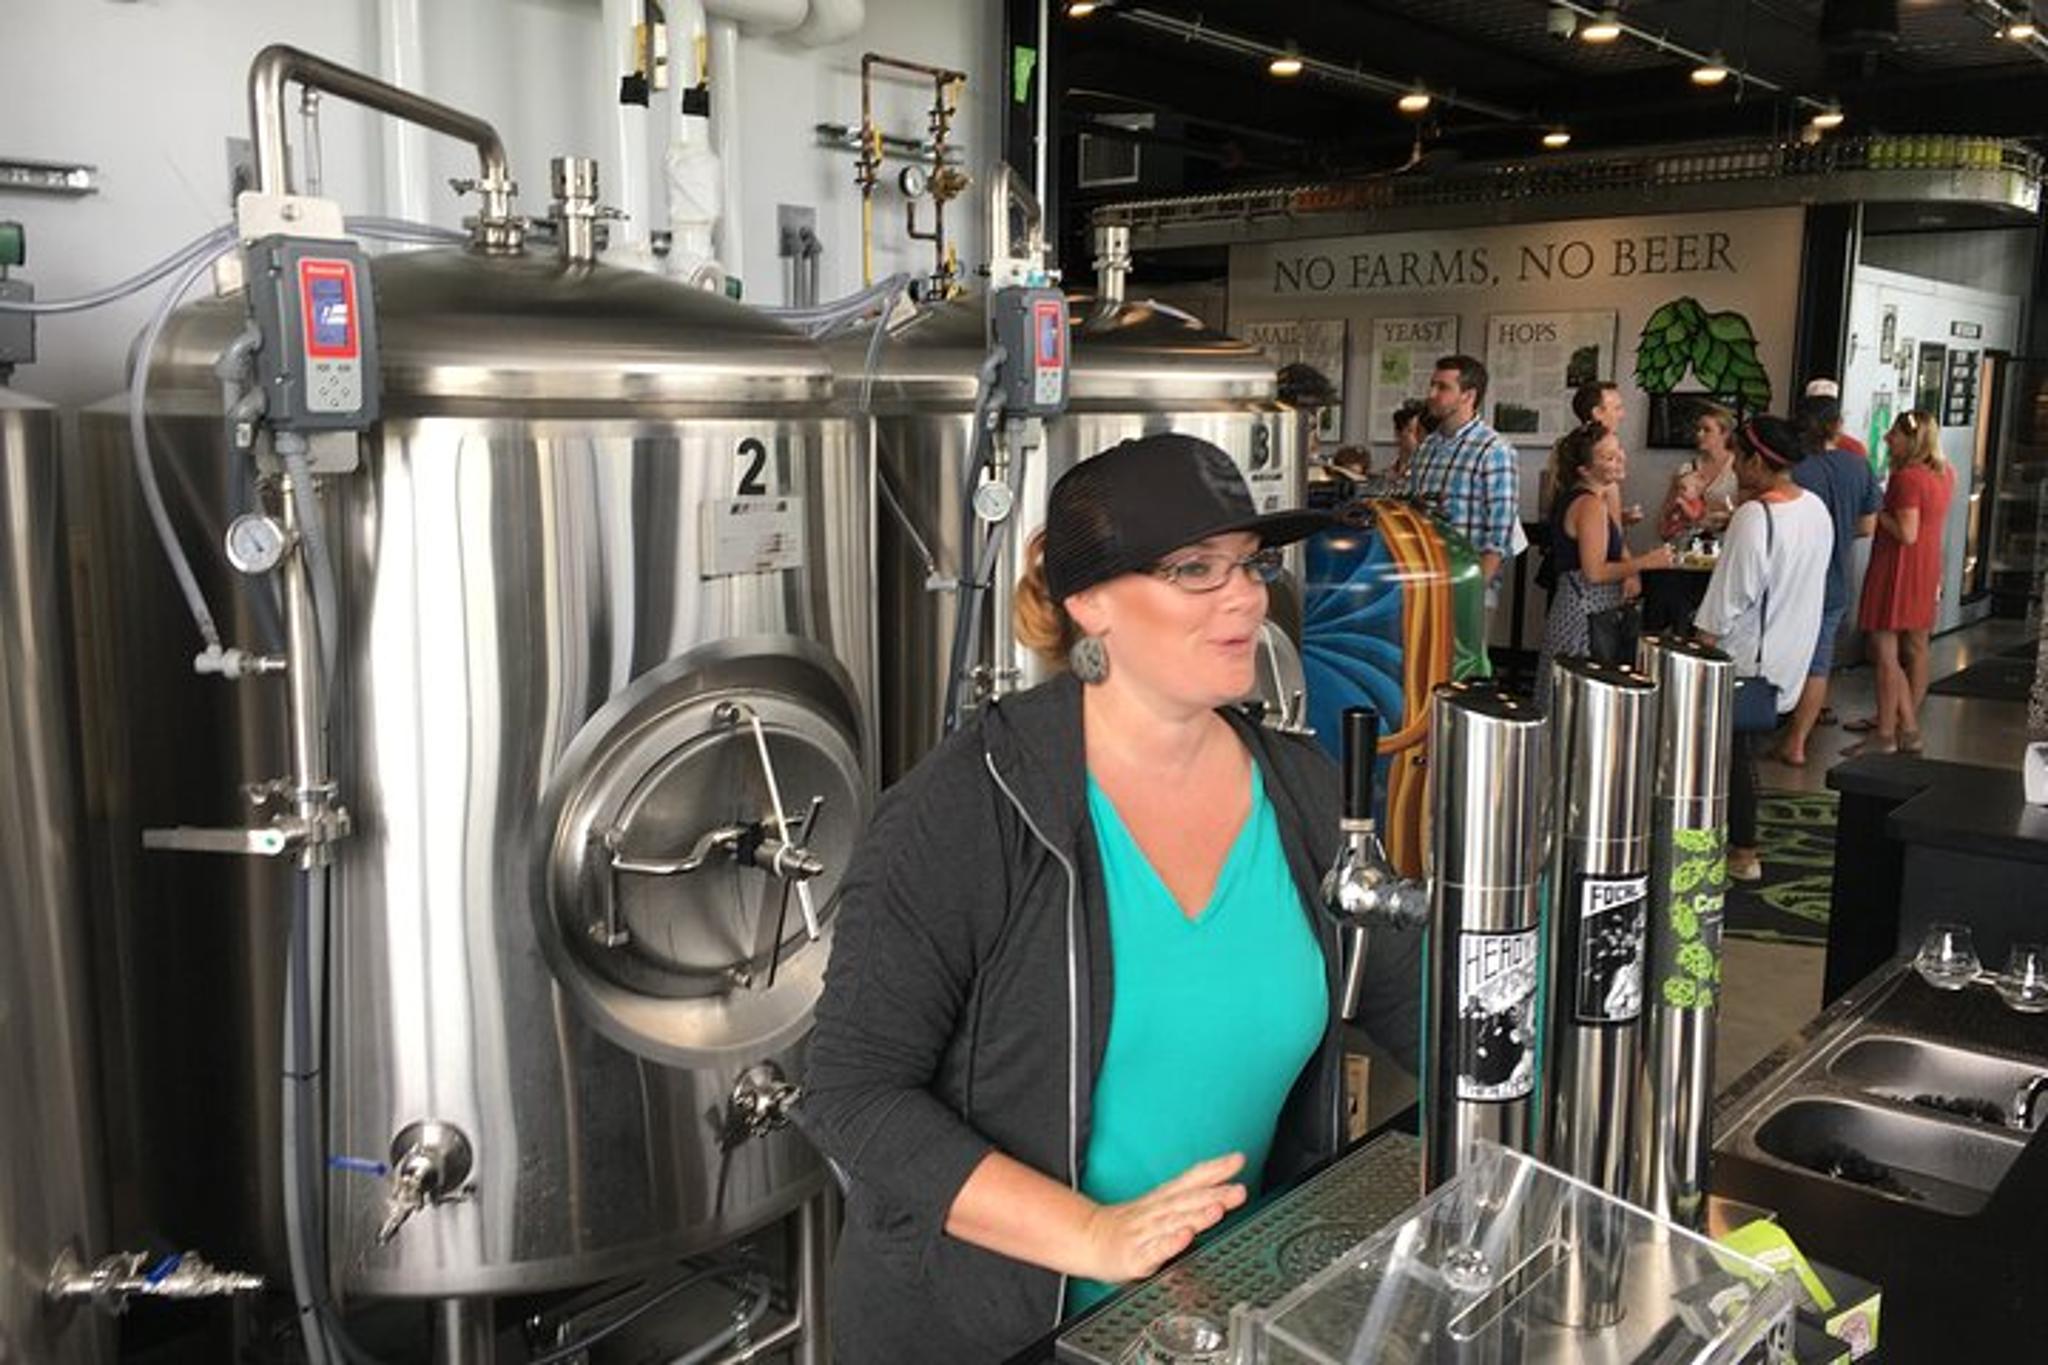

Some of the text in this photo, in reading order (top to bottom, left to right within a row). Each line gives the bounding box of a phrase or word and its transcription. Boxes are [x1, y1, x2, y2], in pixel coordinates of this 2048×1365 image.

[1274, 231, 1738, 294] NO FARMS, NO BEER
[1382, 320, 1448, 343] YEAST
[1499, 321, 1558, 344] HOPS
[737, 437, 767, 496] 2
